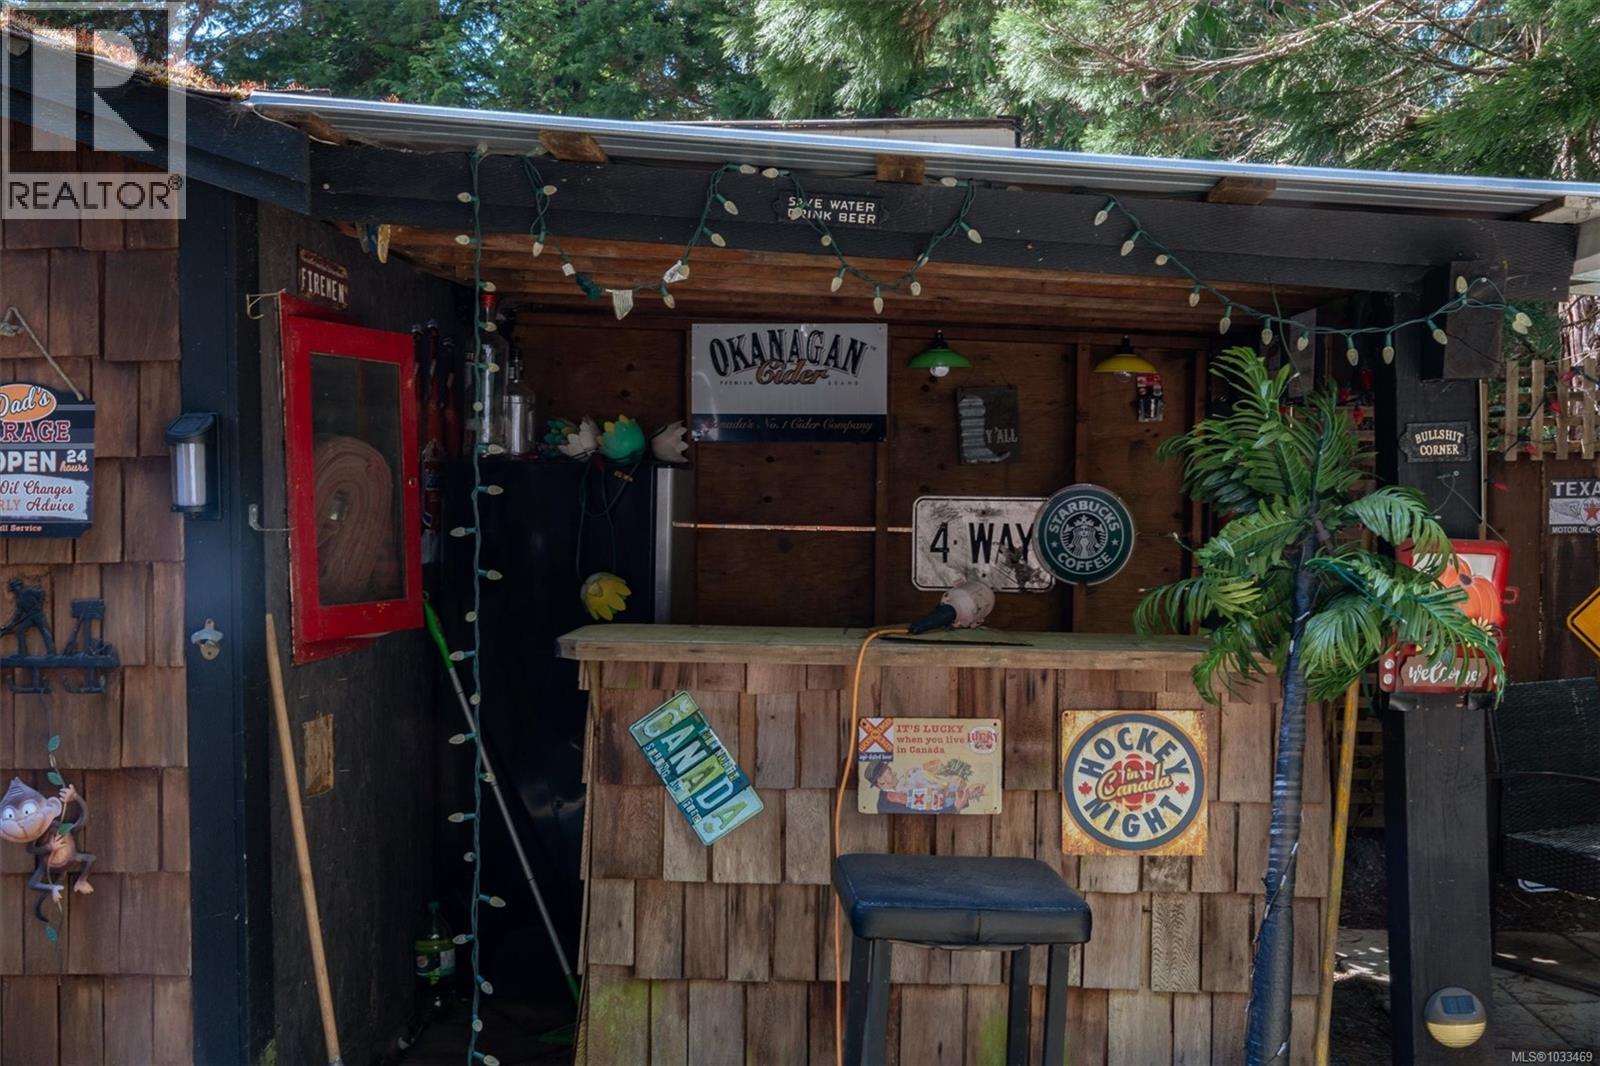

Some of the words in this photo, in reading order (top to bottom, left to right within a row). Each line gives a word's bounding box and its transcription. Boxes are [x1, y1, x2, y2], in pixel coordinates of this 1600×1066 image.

[831, 200, 875, 212] WATER
[839, 212, 876, 224] BEER
[709, 328, 869, 377] OKANAGAN
[755, 359, 829, 385] Cider
[790, 416, 821, 430] Cider
[822, 417, 872, 433] Company
[985, 427, 1018, 443] Y'ALL
[1415, 429, 1464, 445] BULLSHIT
[67, 450, 87, 463] 24
[1419, 443, 1460, 456] CORNER
[60, 461, 89, 472] hours
[0, 480, 19, 494] Oil
[24, 480, 73, 499] Changes
[26, 497, 75, 511] Advice
[1049, 500, 1121, 533] STARBUCKS
[1552, 526, 1578, 534] MOTOR
[1579, 526, 1592, 534] OIL
[929, 522, 950, 563] 4
[968, 522, 1035, 564] WAY
[1057, 551, 1113, 571] COFFEE
[896, 724, 920, 733] IT'S
[923, 724, 964, 733] LUCKY
[896, 735, 924, 744] when
[926, 736, 944, 746] you
[946, 735, 965, 744] live
[1078, 727, 1190, 779] HOCKEY
[643, 708, 749, 830] CANADA
[1125, 767, 1140, 780] in
[1096, 763, 1174, 801] Canada
[1083, 795, 1183, 837] NIGHT
